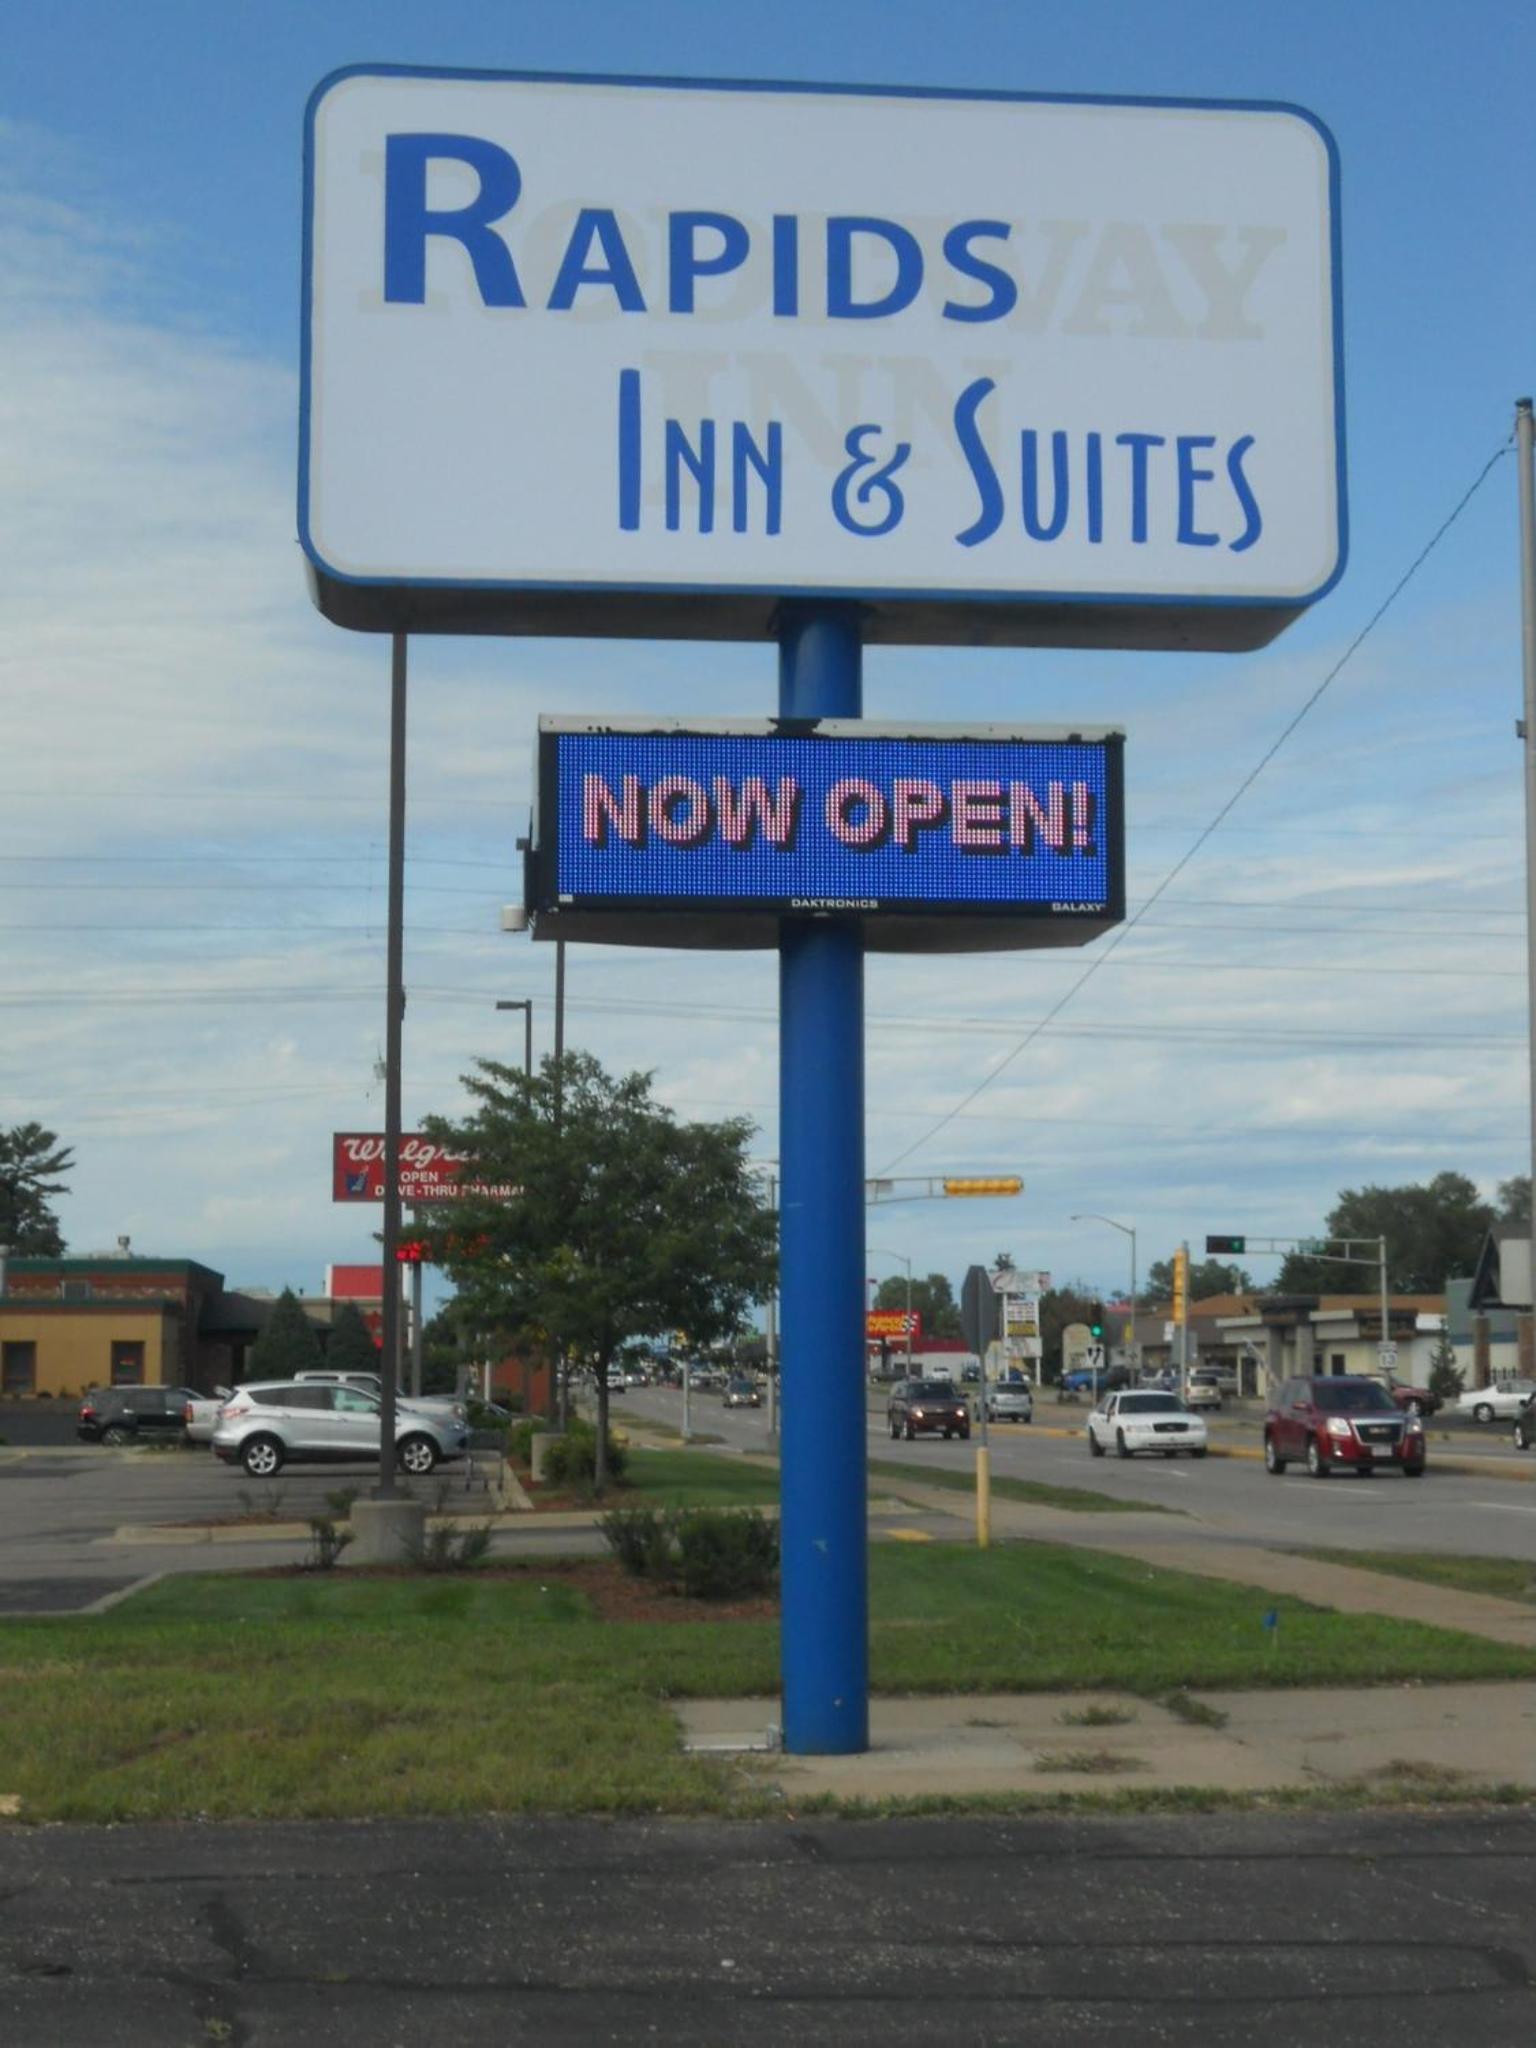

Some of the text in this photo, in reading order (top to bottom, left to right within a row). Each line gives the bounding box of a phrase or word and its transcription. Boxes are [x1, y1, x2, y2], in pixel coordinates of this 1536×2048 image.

[384, 132, 1018, 324] RAPIDS
[618, 368, 1263, 554] INN & SUITES
[582, 774, 1090, 847] NOW OPEN!
[791, 898, 879, 909] DAKTRONICS
[1052, 902, 1102, 912] GALAXY
[400, 1171, 439, 1183] OPEN
[374, 1184, 458, 1197] DVE-THRU
